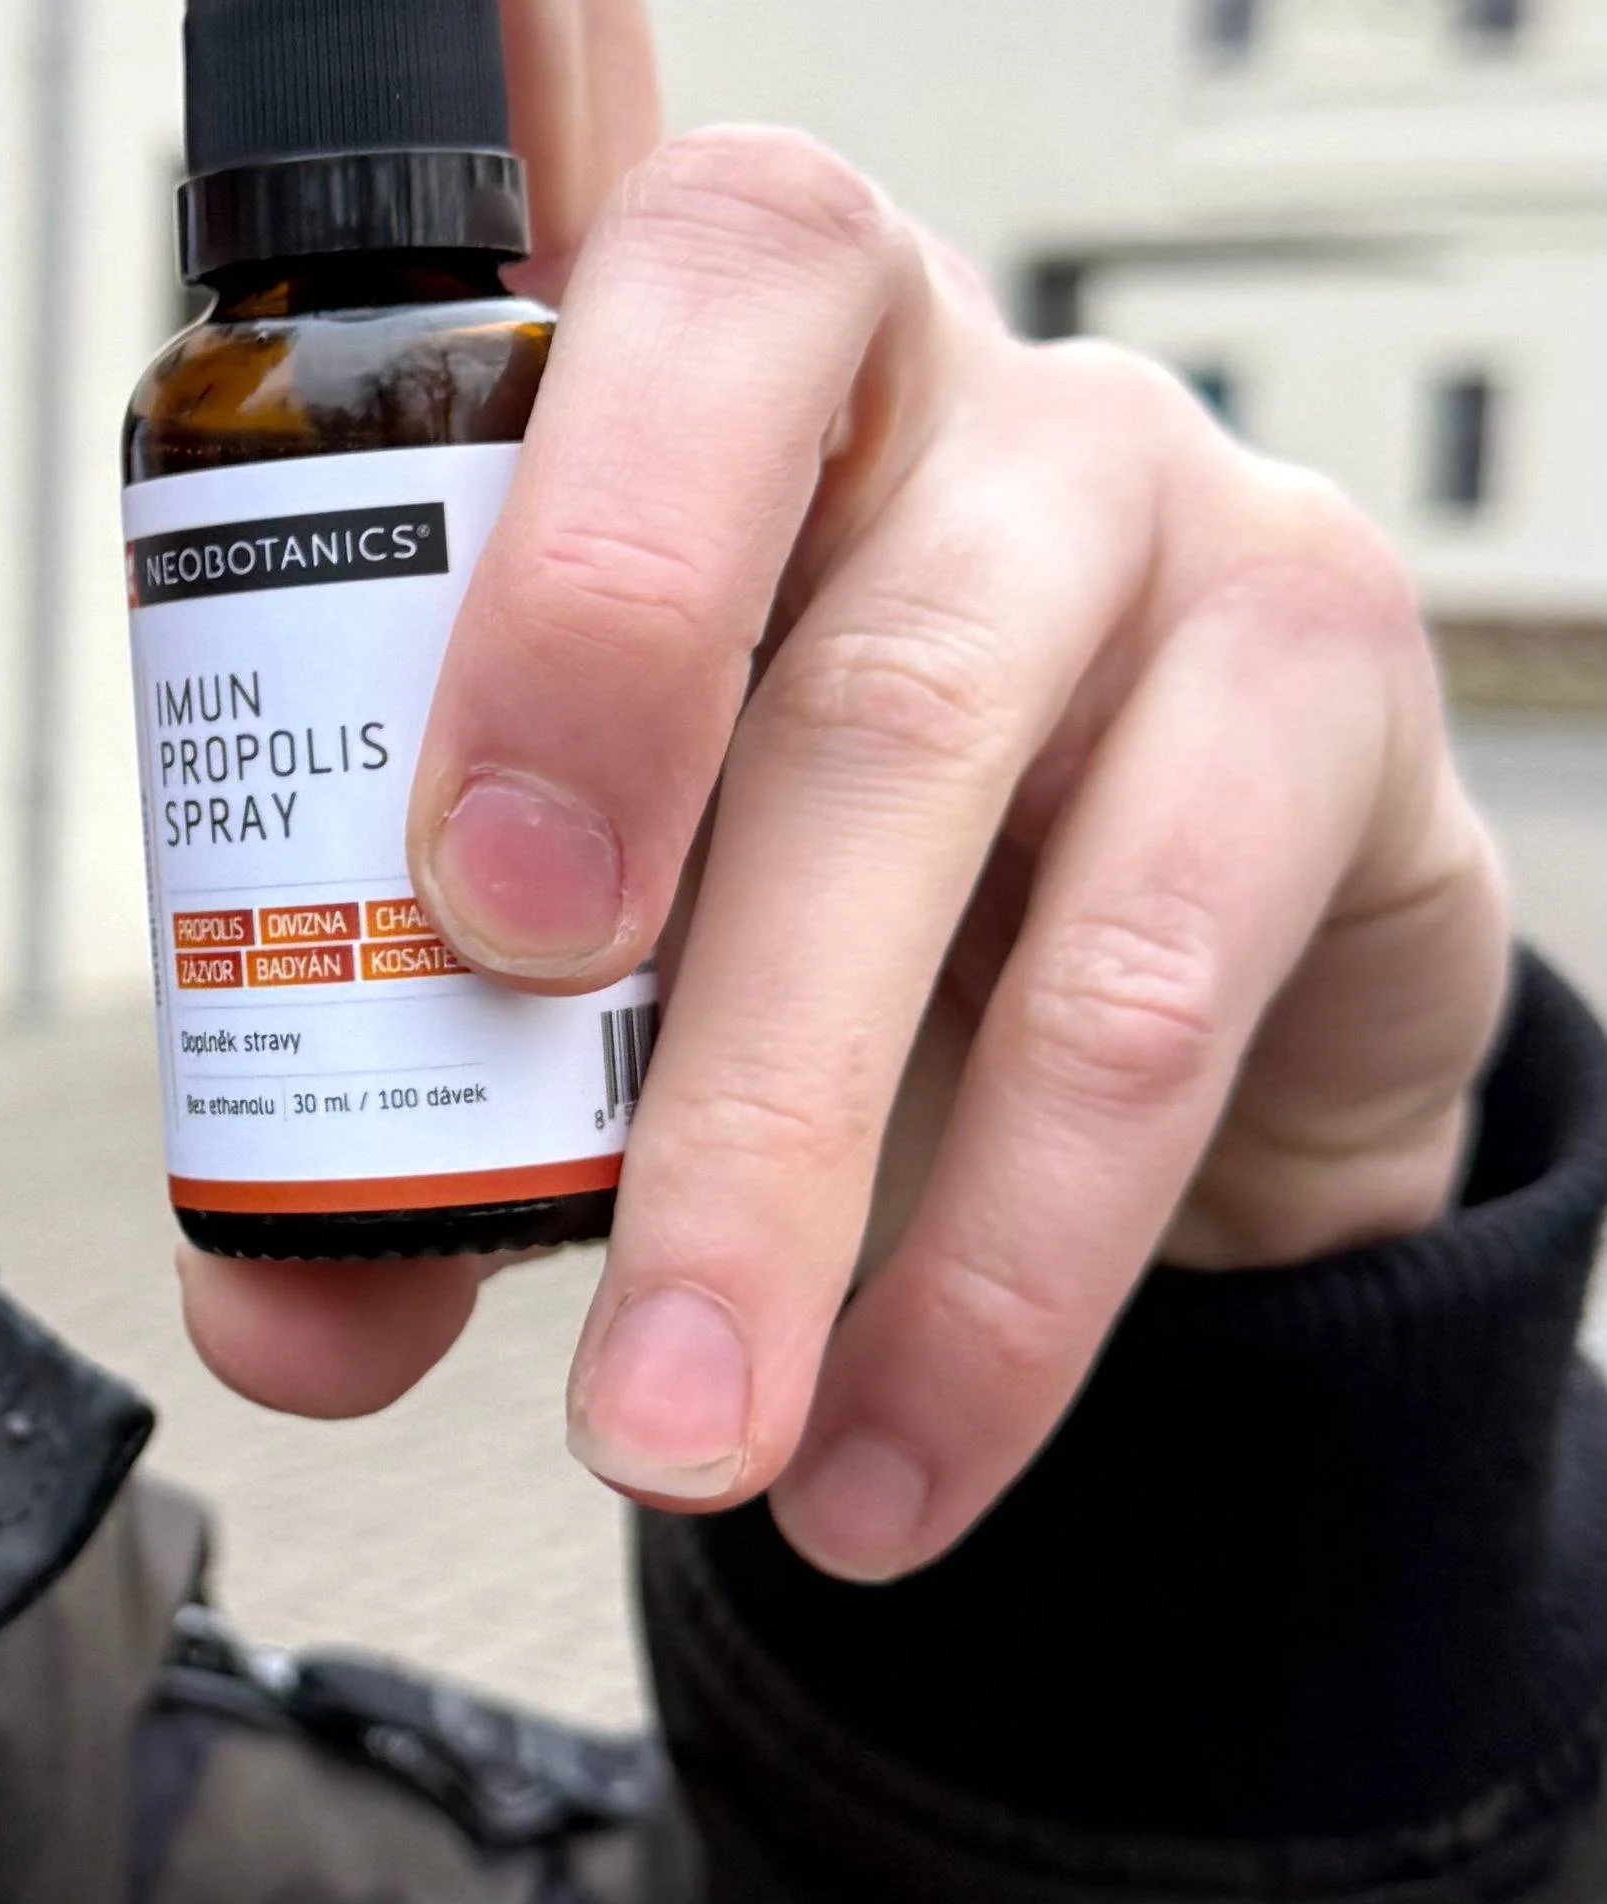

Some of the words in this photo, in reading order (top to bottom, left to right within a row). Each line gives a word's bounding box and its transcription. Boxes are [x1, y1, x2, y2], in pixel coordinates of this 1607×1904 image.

[156, 670, 261, 728] IMUN
[160, 722, 388, 788] PROPOLIS
[165, 791, 298, 847] SPRAY
[178, 917, 244, 942] PROPOLIS
[268, 910, 347, 938] DIVIZNA
[256, 951, 341, 981] BADYÁN
[371, 945, 458, 974] KOSATE
[181, 1029, 238, 1054] Doplněk
[244, 1031, 301, 1055] stravy
[186, 1094, 206, 1114] Bez
[209, 1096, 275, 1115] ethanolu
[293, 1093, 316, 1114] 30
[325, 1092, 351, 1112] ml
[360, 1091, 368, 1111] /
[378, 1087, 418, 1110] 100
[426, 1083, 487, 1107] dávek
